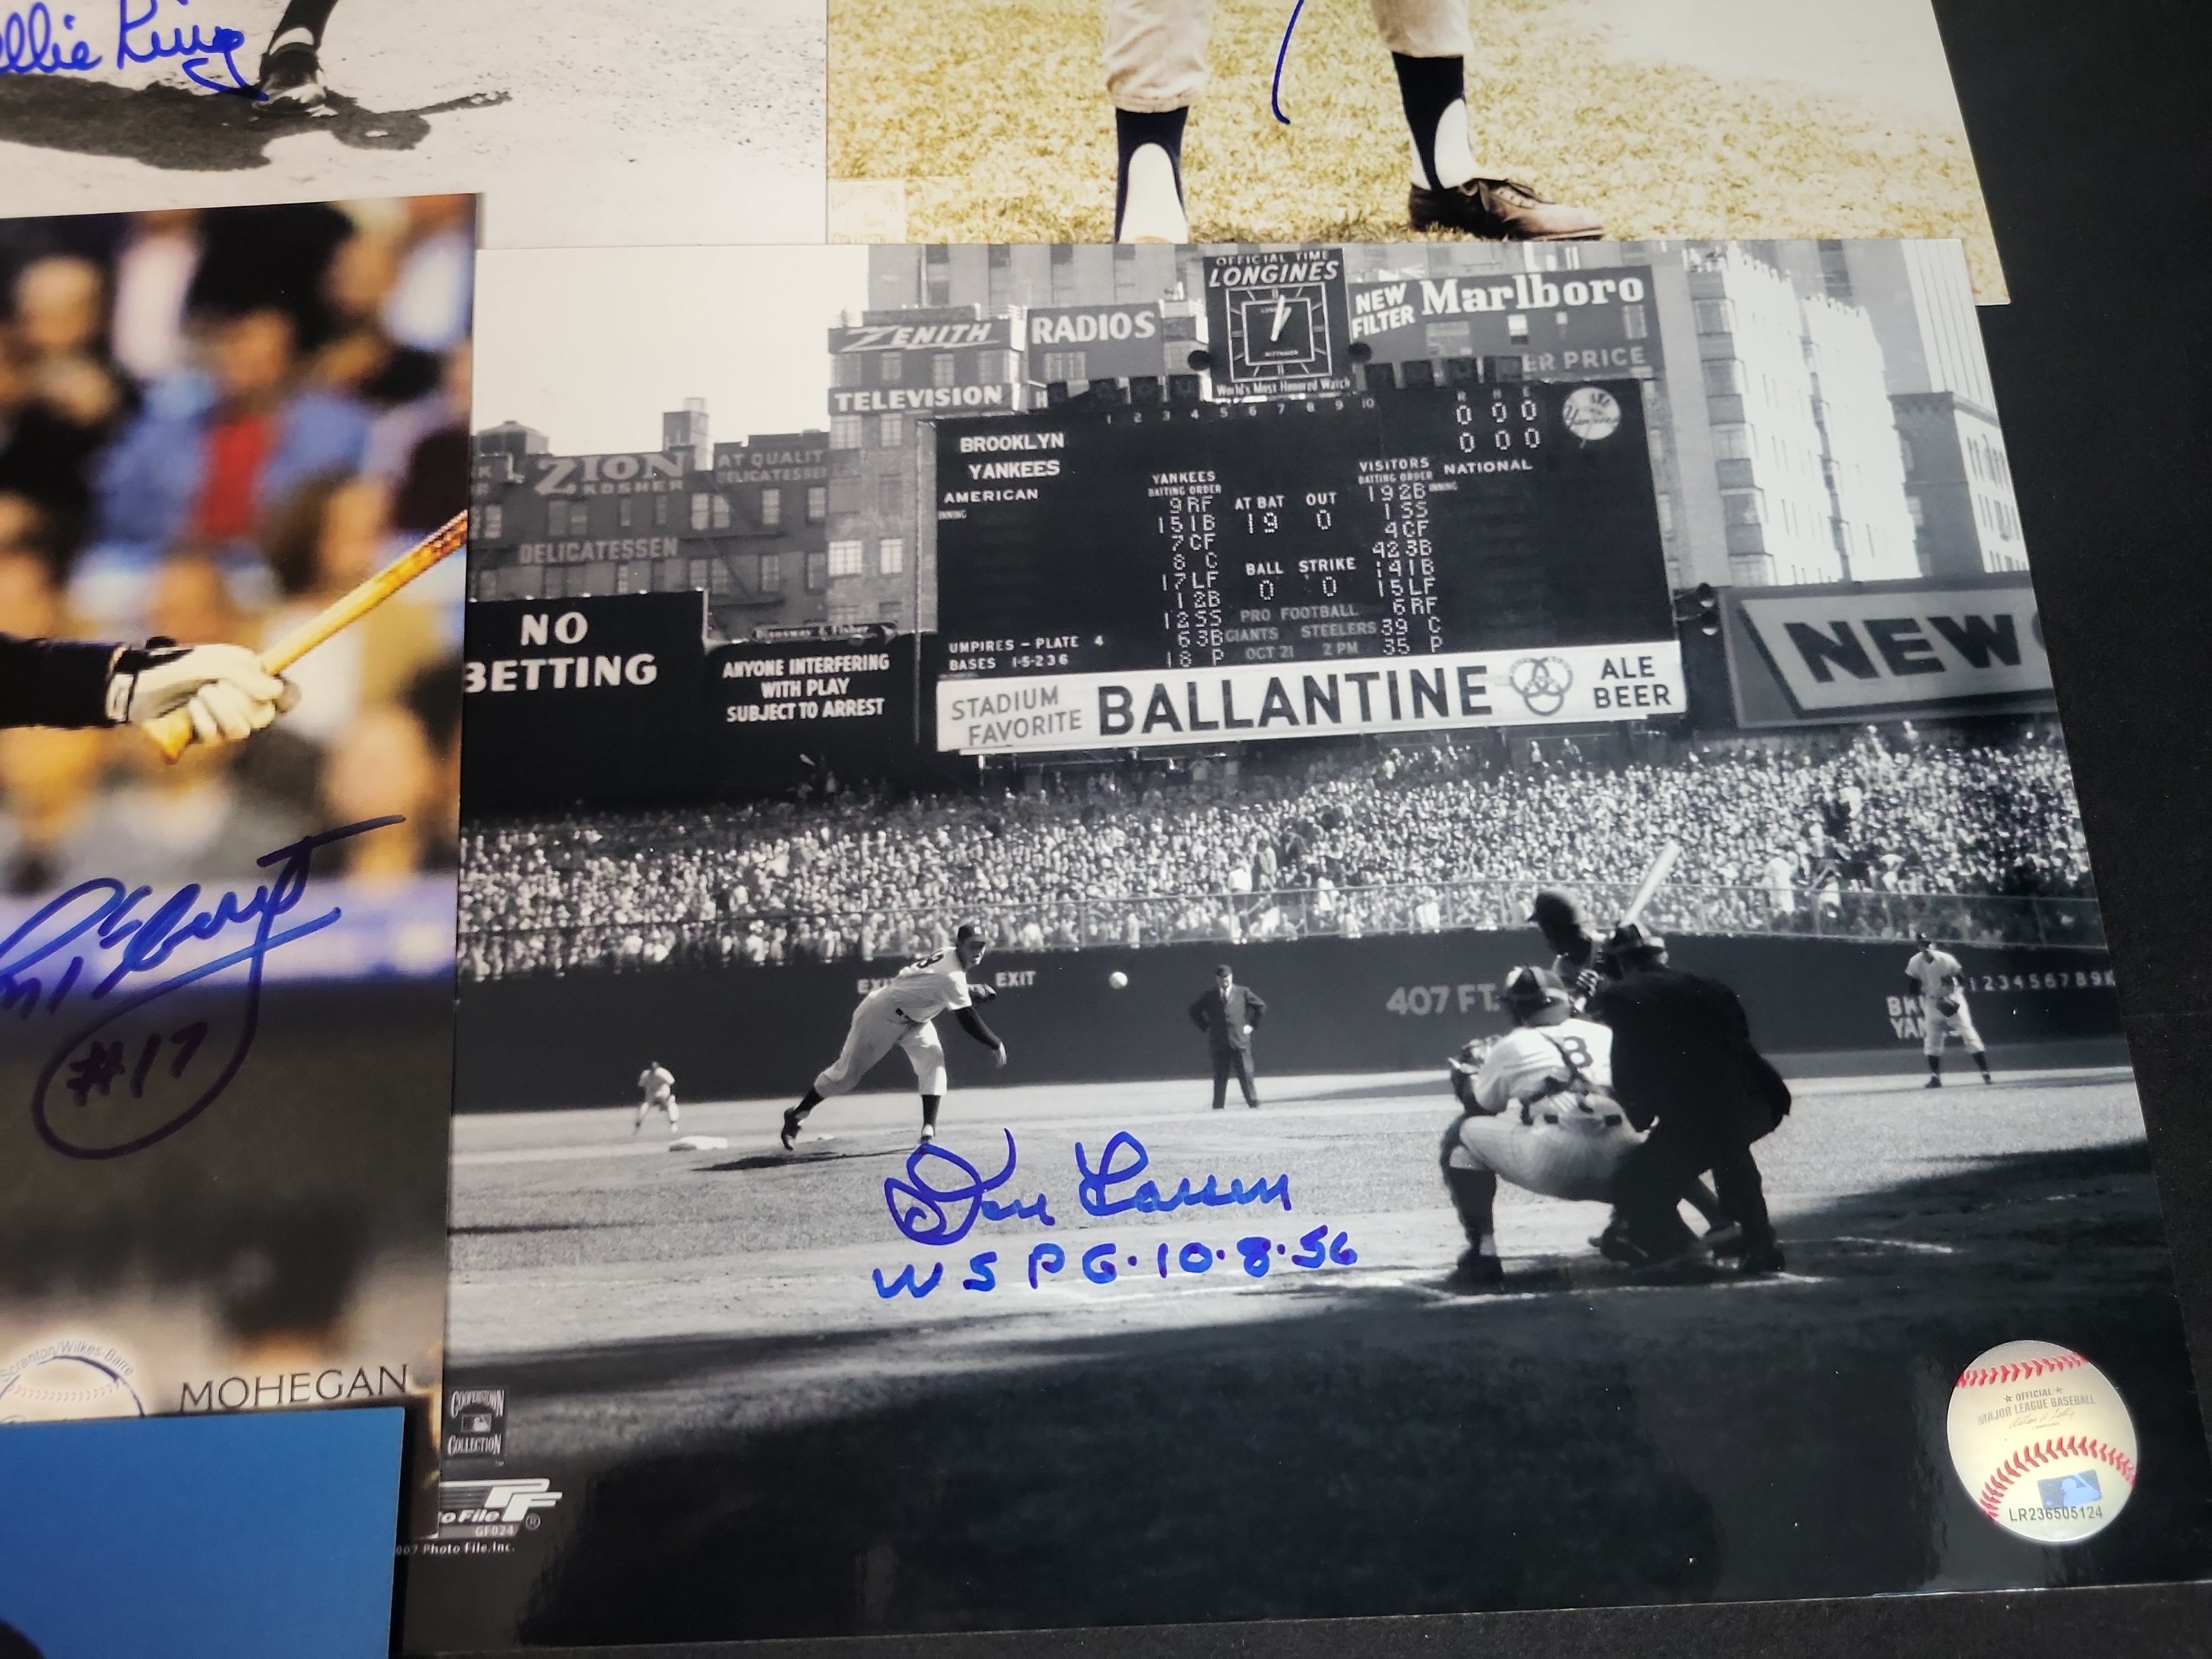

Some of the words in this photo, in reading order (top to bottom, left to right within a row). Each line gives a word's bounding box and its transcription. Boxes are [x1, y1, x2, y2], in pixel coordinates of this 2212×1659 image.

[1209, 260, 1339, 287] LONGINES
[1355, 283, 1407, 314] NEW
[1420, 273, 1645, 316] Marlboro
[1032, 311, 1156, 344] RADIOS
[1352, 306, 1416, 339] FILTER
[839, 322, 999, 353] ZENITH
[1564, 346, 1647, 369] PRICE
[834, 385, 1002, 411] TELEVISION
[1457, 405, 1472, 425] 0
[1493, 403, 1507, 422] 0
[1521, 400, 1536, 421] 0
[960, 432, 1065, 453] BROOKLYN
[1459, 432, 1475, 453] 0
[1495, 430, 1510, 450] 0
[1525, 427, 1540, 448] 0
[535, 451, 687, 497] ZION
[968, 460, 1060, 479] YANKEES
[1359, 457, 1430, 473] VISITORS
[1444, 459, 1533, 475] NATIONAL
[583, 479, 684, 495] KOSHER
[1152, 471, 1215, 484] YANKEES
[944, 489, 1039, 503] AMERICAN
[1235, 498, 1252, 510] AT
[1256, 495, 1285, 509] BAT
[1306, 492, 1337, 507] OUT
[1248, 512, 1278, 534] 19
[1317, 509, 1332, 530] 0
[519, 538, 679, 565] DELICATESSEN
[1245, 562, 1284, 576] BALL
[1298, 557, 1356, 573] STRIKE
[1259, 580, 1274, 601] 0
[1322, 576, 1337, 597] 0
[1240, 609, 1271, 623] PRO
[1280, 603, 1359, 621] FOOTBALL
[521, 611, 588, 646] NO
[1224, 627, 1279, 643] GIANTS
[1301, 620, 1378, 638] STEELERS
[948, 639, 1015, 654] UMPIRES
[1035, 637, 1079, 650] PLATE
[1245, 646, 1272, 660] OCT
[1337, 640, 1359, 654] PM
[465, 653, 658, 694] BETTING
[722, 659, 785, 679] ANYONE
[789, 654, 890, 675] INTERFERING
[949, 657, 996, 671] BASES
[1600, 656, 1655, 681] ALE
[761, 680, 801, 698] WITH
[807, 677, 851, 696] PLAY
[1593, 684, 1672, 709] BEER
[726, 702, 796, 723] SUBJECT
[798, 702, 818, 719] TO
[822, 697, 885, 719] ARREST
[952, 685, 1059, 720] STADIUM
[1098, 665, 1493, 736] BALLANTINE
[969, 709, 1083, 747] FAVORITE
[995, 971, 1037, 988] EXIT
[1386, 985, 1451, 1015] 407
[66, 1021, 208, 1106] #17
[180, 1363, 410, 1413] MOHEGAN
[2015, 1388, 2052, 1401] OFFICIAL
[1978, 1406, 2012, 1426] MAJOR
[2014, 1398, 2048, 1414] LEAGUE
[2051, 1395, 2096, 1408] BASEBALL
[2008, 1505, 2103, 1522] LR236505124
[423, 1542, 461, 1556] Photo
